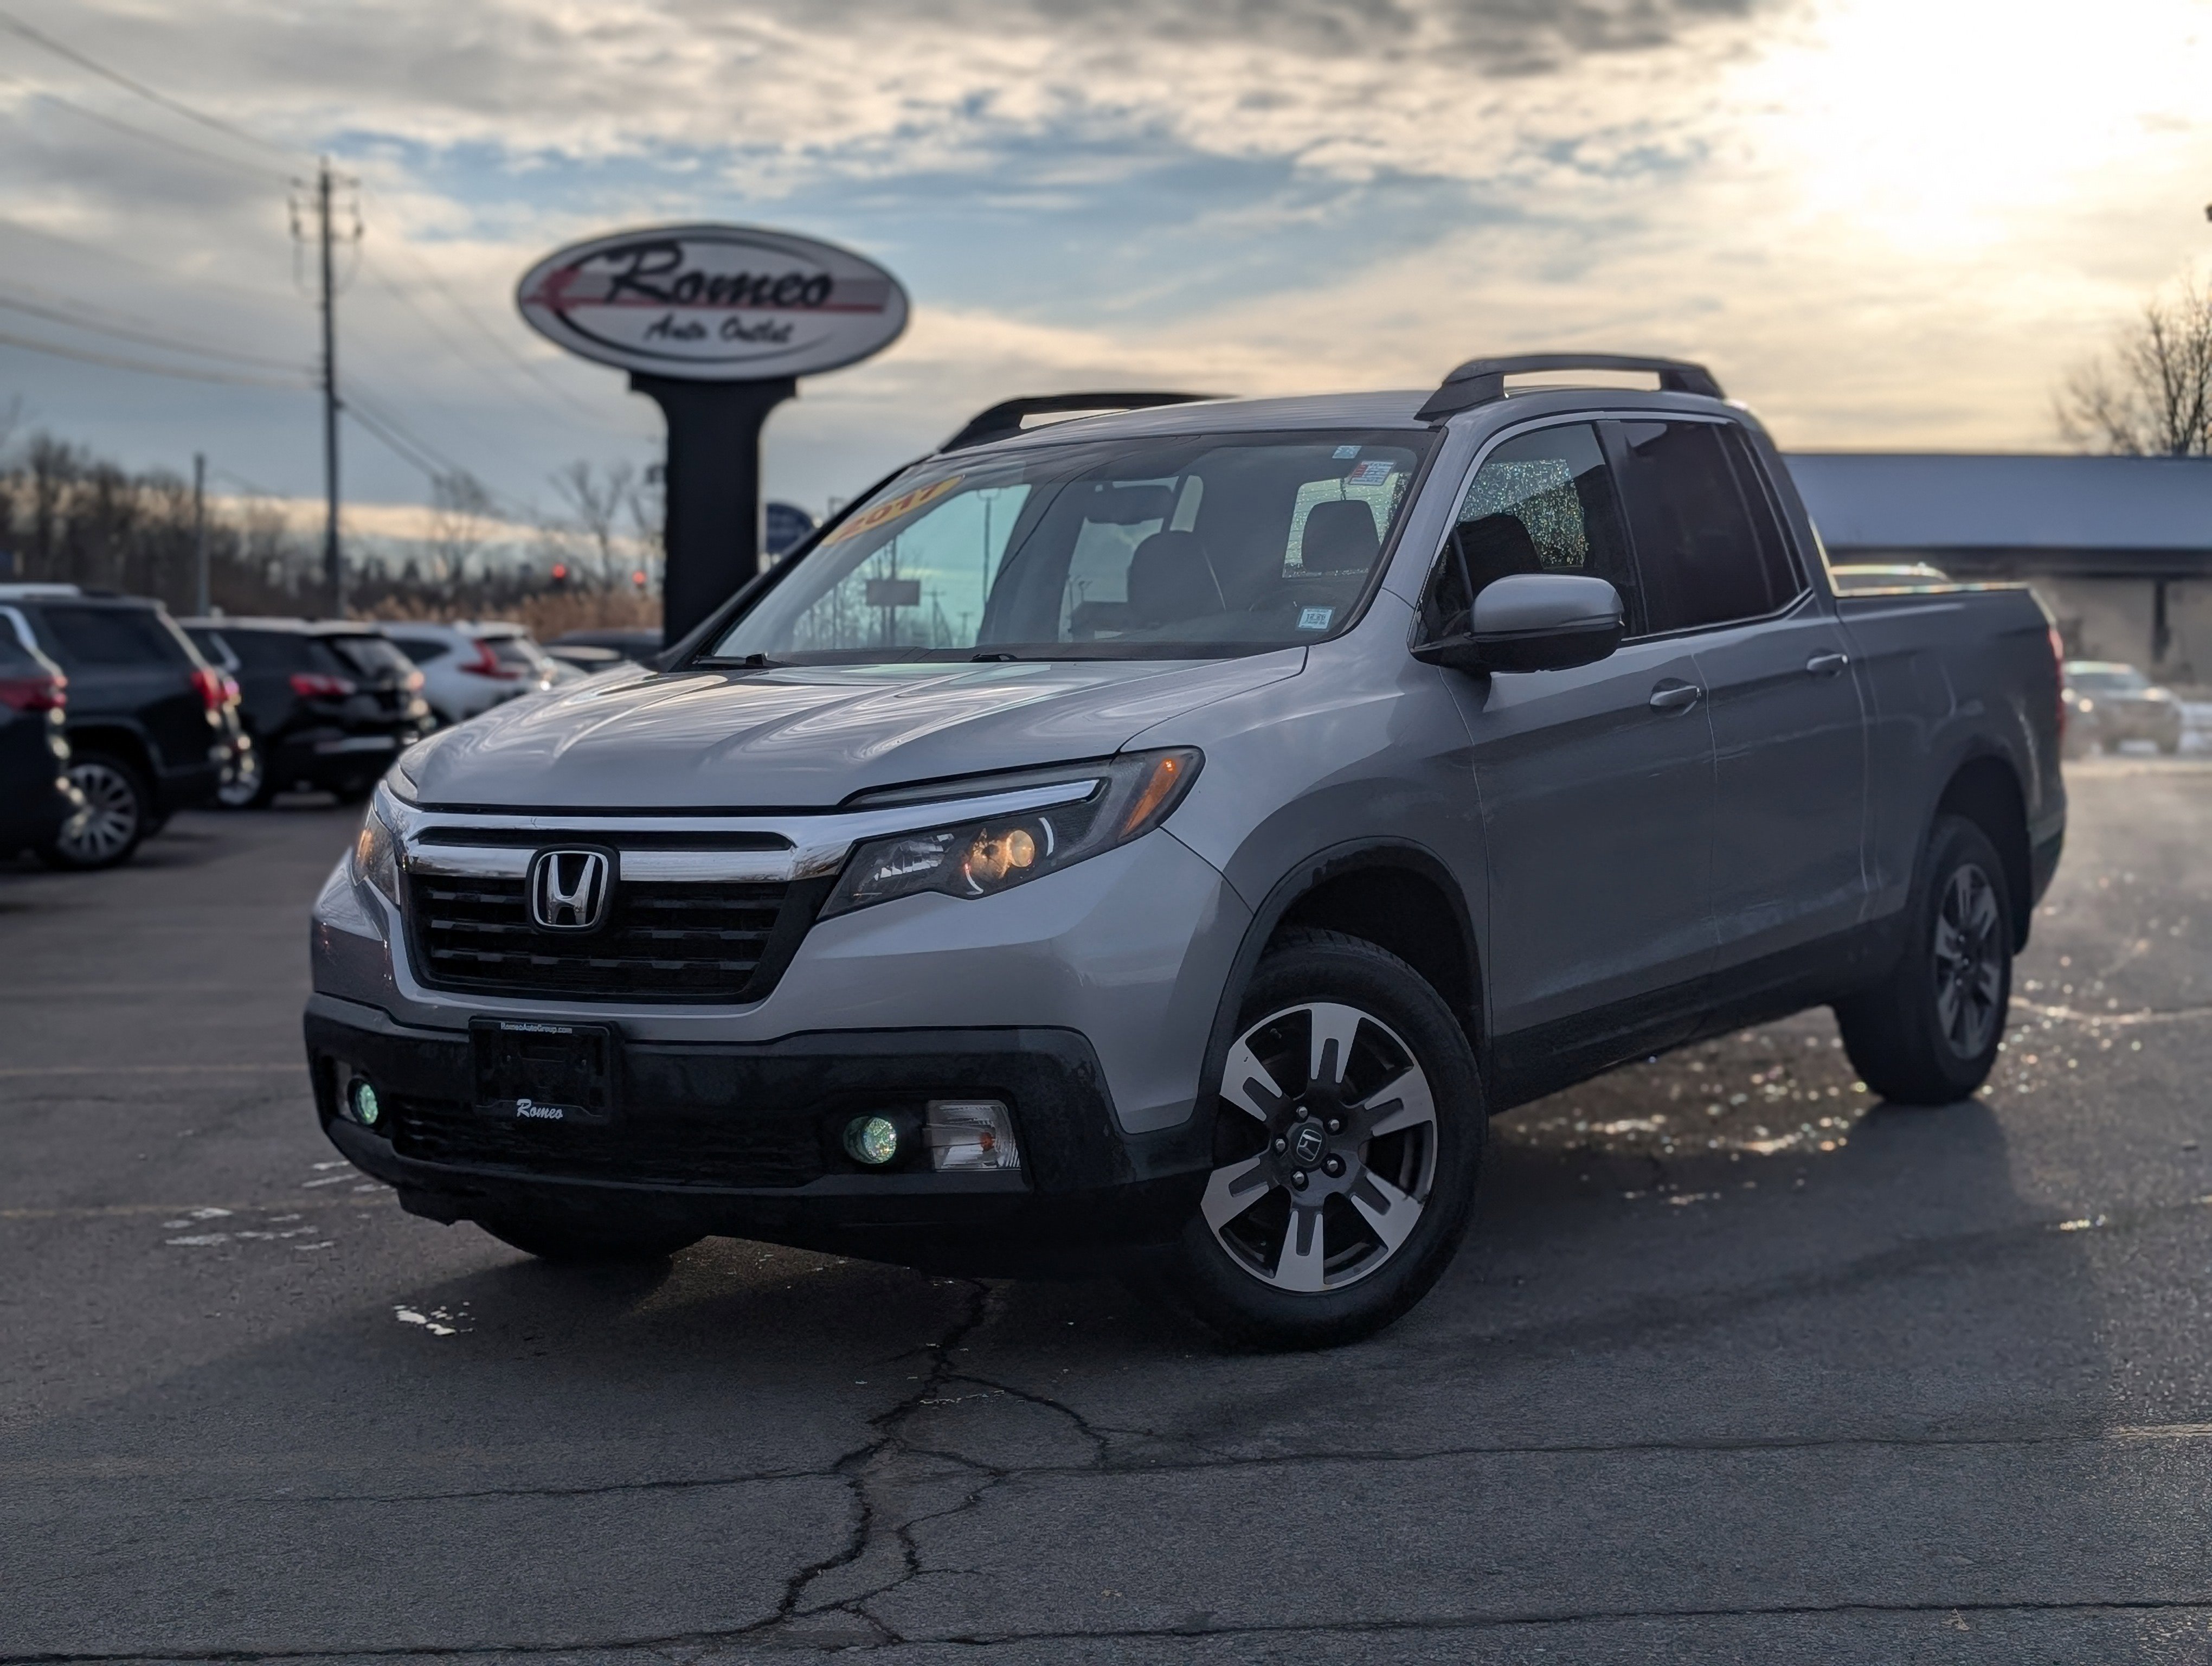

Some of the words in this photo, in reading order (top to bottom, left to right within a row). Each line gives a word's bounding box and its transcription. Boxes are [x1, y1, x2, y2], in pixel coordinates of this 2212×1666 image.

[603, 239, 833, 306] Romeo
[836, 480, 945, 541] 2017
[517, 1099, 563, 1119] Romeo
